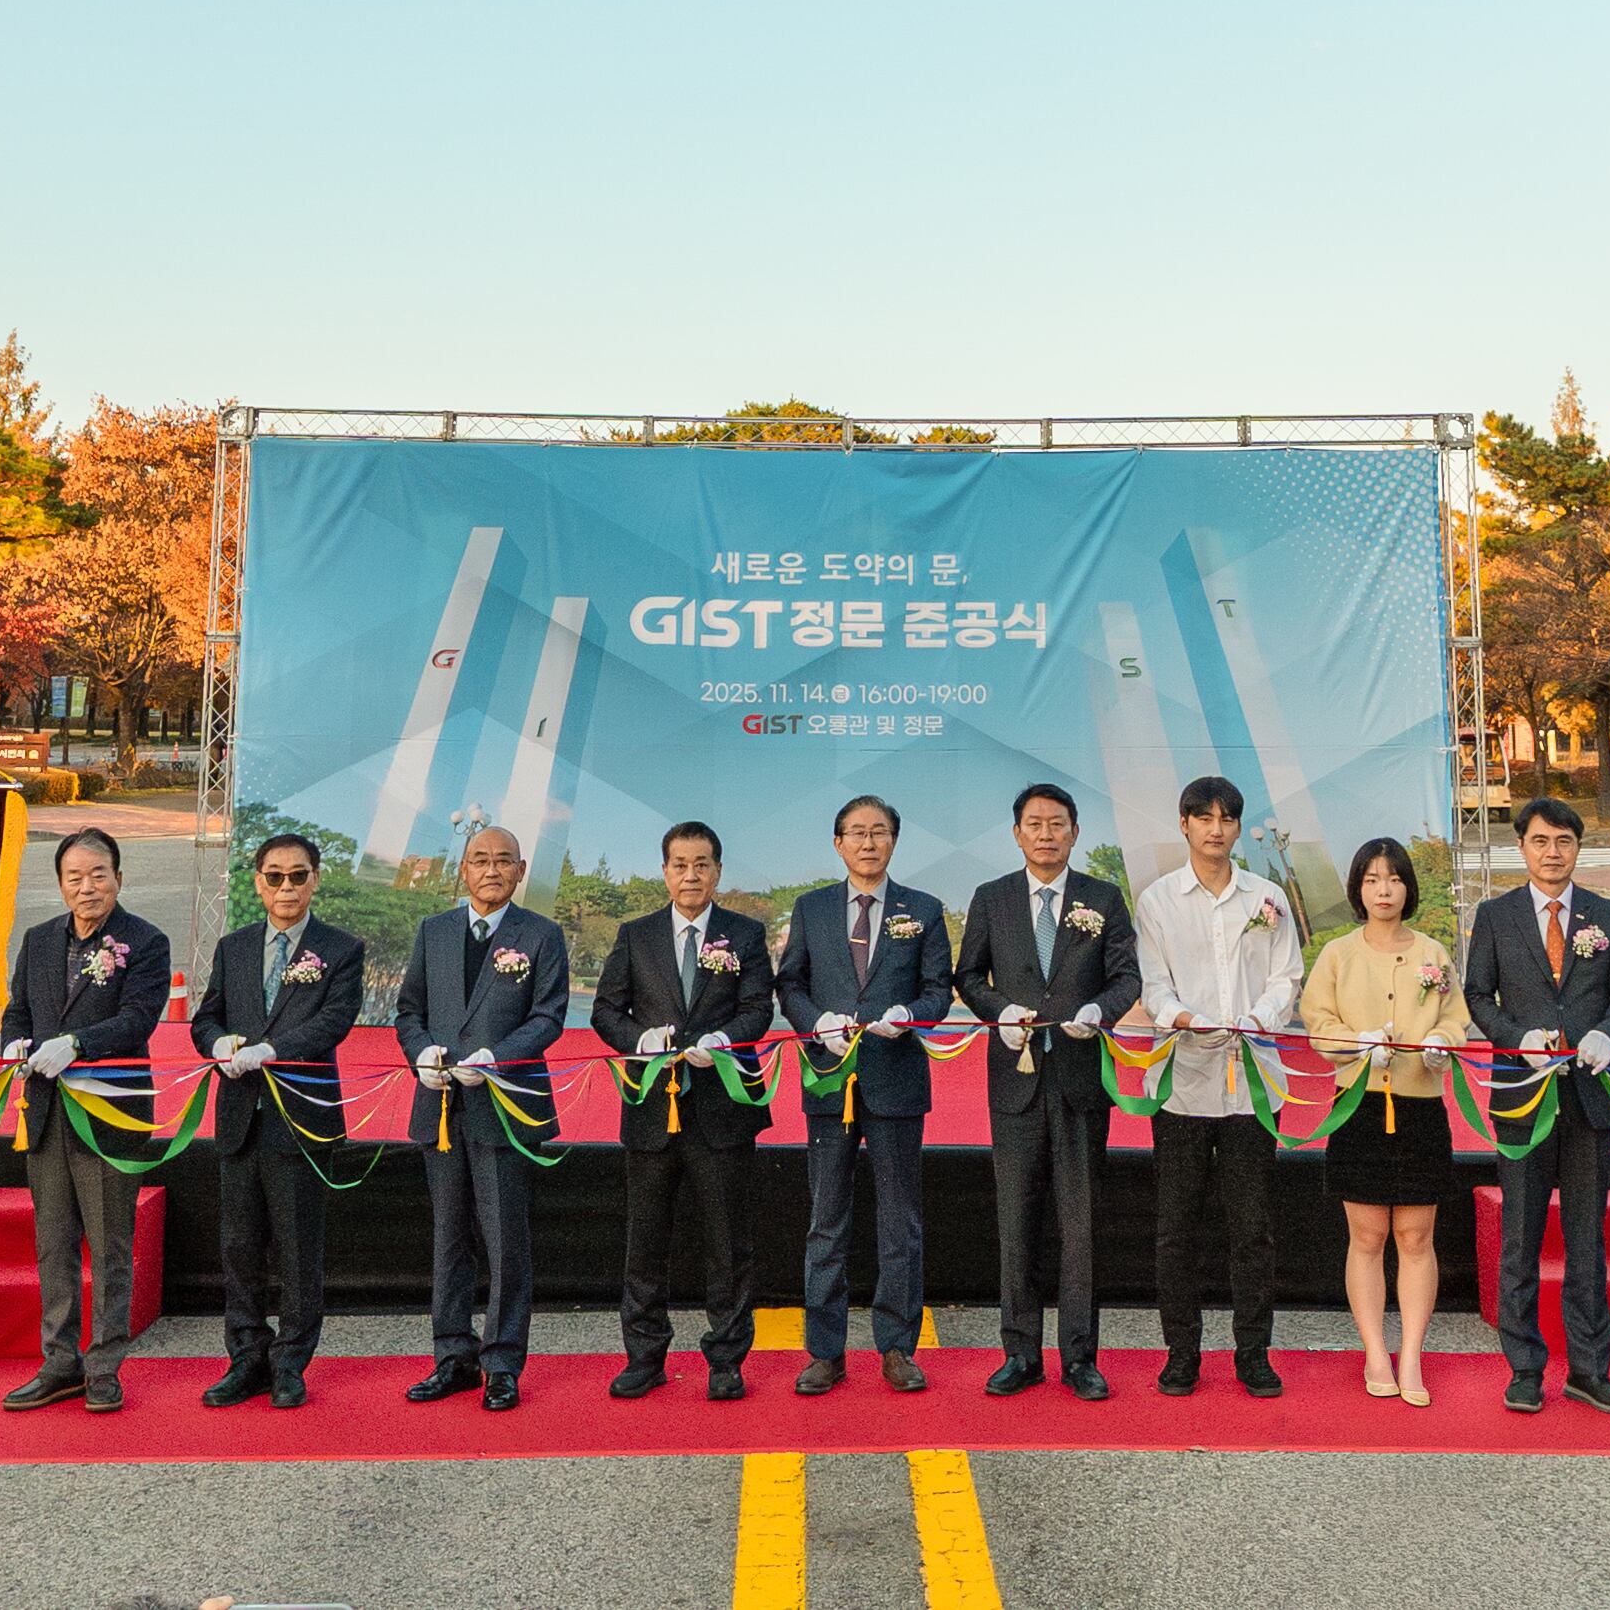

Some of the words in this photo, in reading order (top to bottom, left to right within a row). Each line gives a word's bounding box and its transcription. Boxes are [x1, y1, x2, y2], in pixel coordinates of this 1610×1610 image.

[710, 552, 807, 585] 새로운
[819, 553, 915, 586] 도약의
[929, 554, 968, 586] 문,
[1216, 599, 1236, 618] T
[902, 601, 1047, 650] 준공식
[432, 649, 461, 669] G
[1119, 657, 1142, 678] S
[700, 682, 763, 704] 2025.
[770, 683, 793, 704] 11.
[858, 684, 988, 705] 16:00-19:00
[742, 714, 803, 735] GIST
[807, 715, 870, 736] 오룡관
[877, 715, 896, 736] 및
[903, 715, 944, 736] 정문
